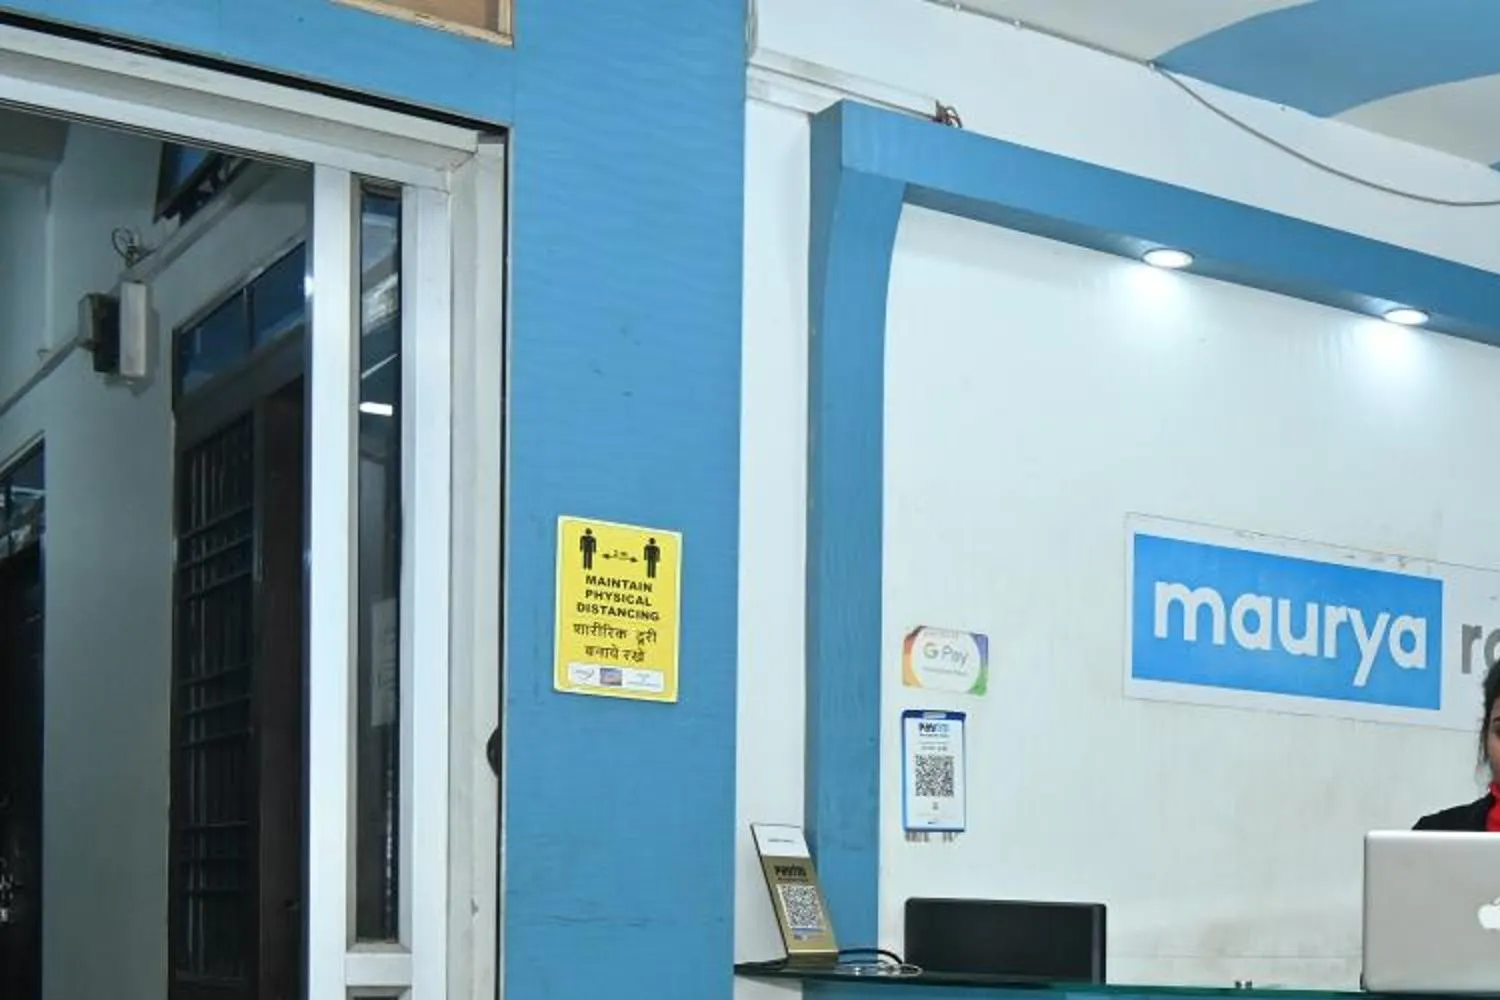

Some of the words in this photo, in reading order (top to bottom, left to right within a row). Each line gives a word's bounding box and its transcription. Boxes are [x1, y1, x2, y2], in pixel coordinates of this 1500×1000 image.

[585, 575, 653, 593] MAINTAIN
[585, 589, 653, 607] PHYSICAL
[576, 602, 660, 621] DISTANCING
[1154, 581, 1427, 686] maurya
[942, 643, 969, 669] Pay
